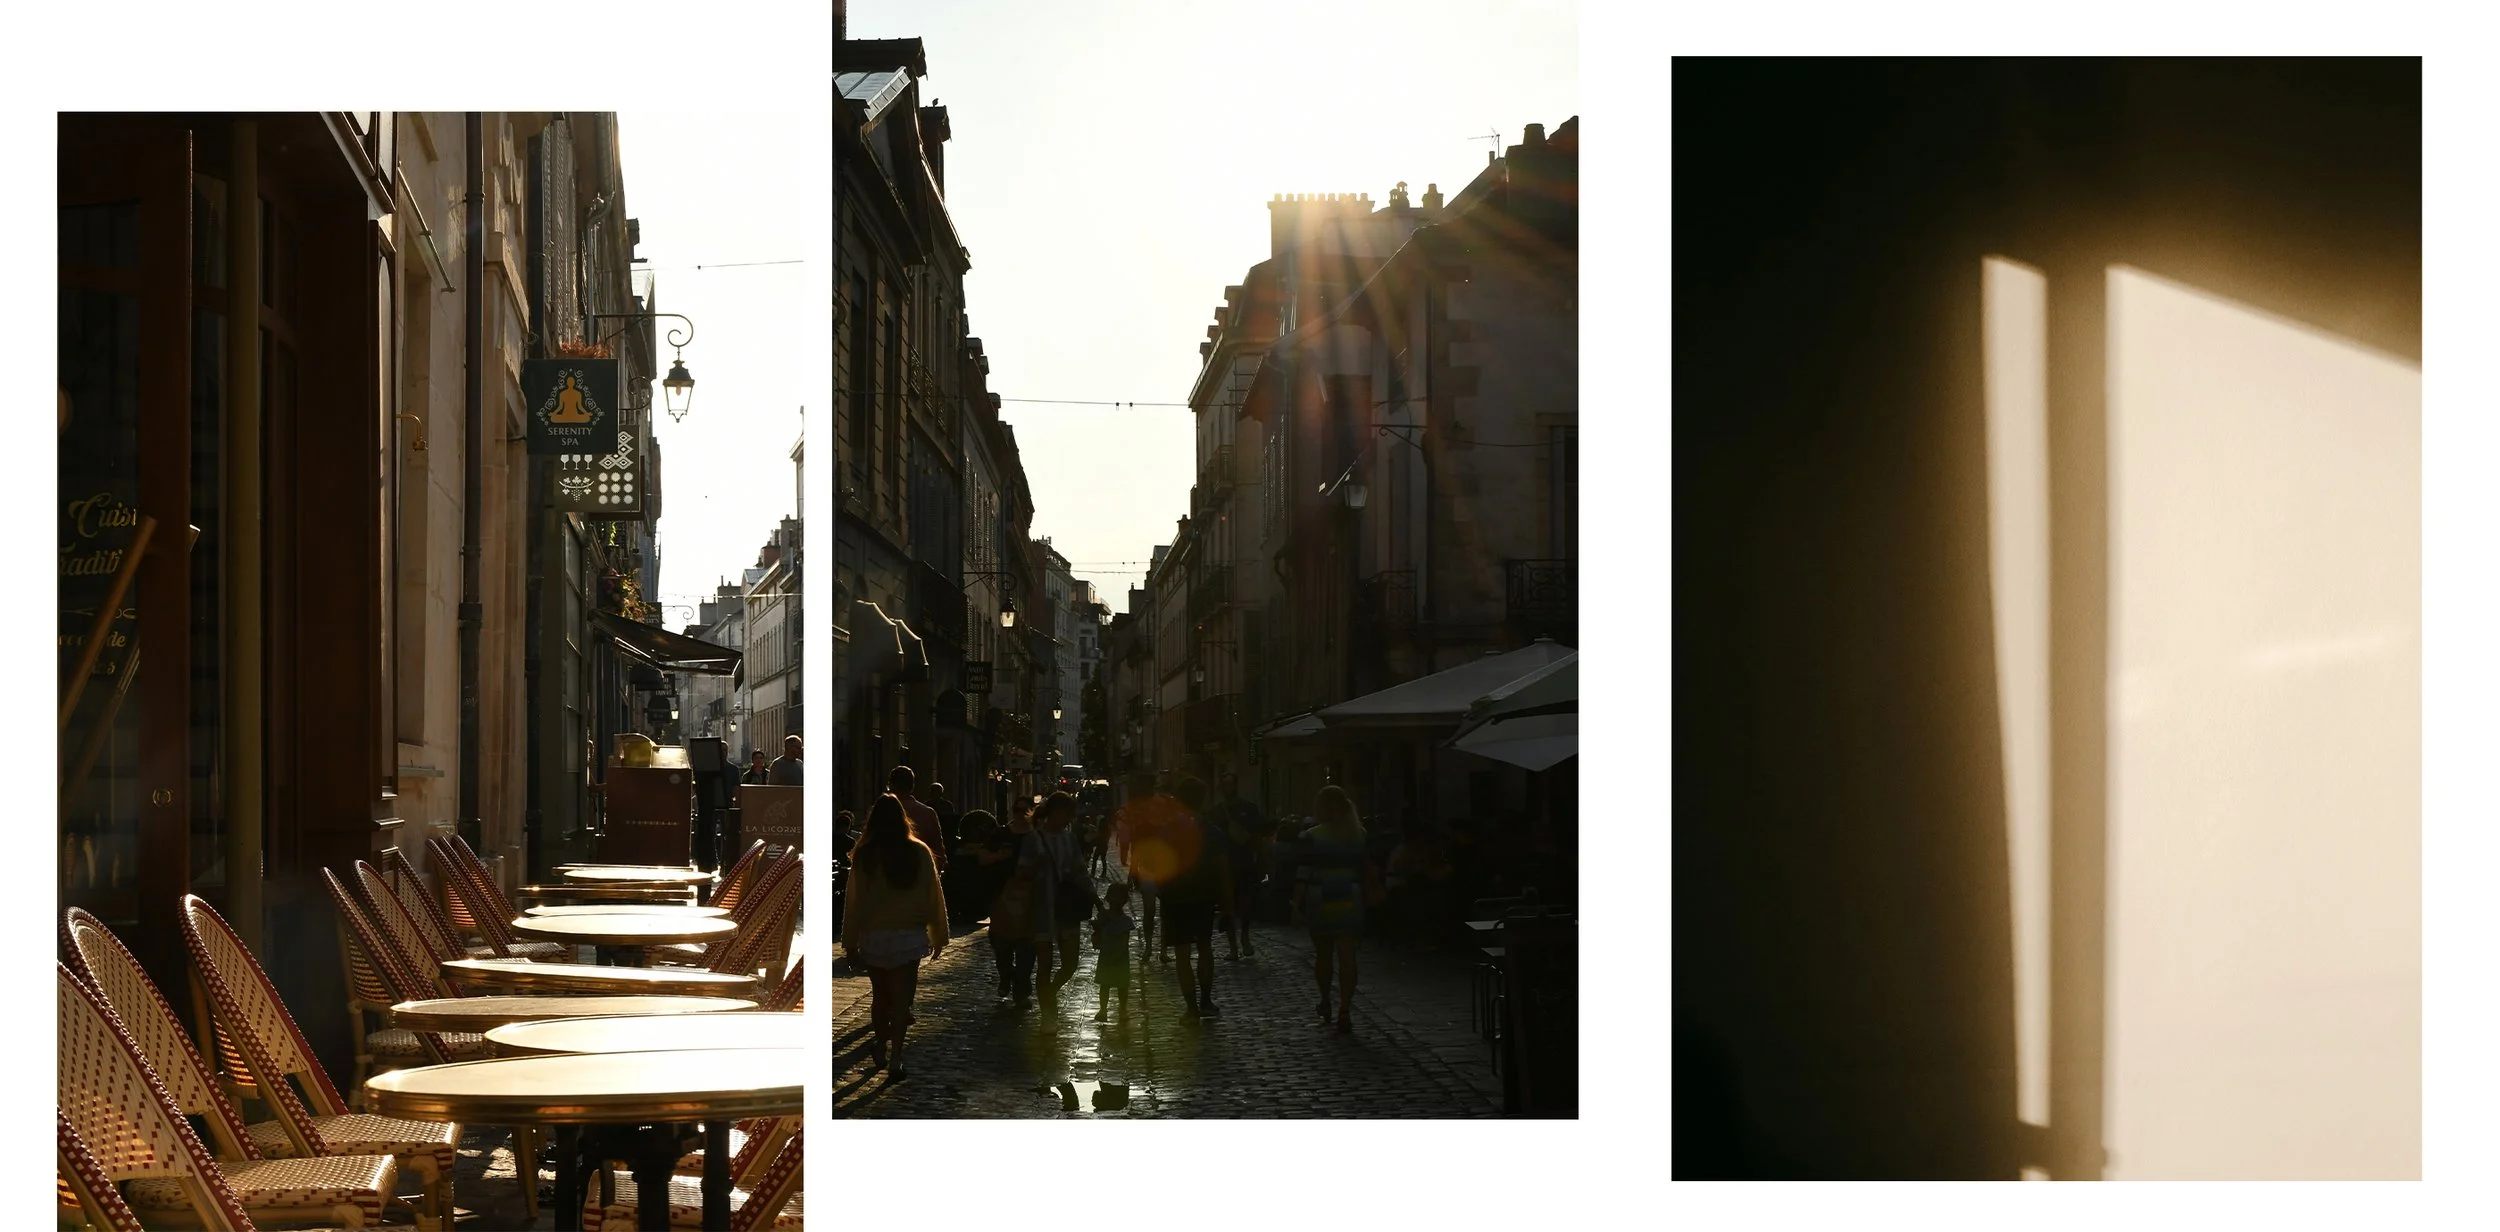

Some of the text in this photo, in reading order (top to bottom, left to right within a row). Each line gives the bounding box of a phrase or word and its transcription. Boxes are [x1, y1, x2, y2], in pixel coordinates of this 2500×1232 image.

[547, 427, 592, 435] SERENITY
[561, 437, 579, 446] SPA
[762, 825, 800, 834] LICORNE
